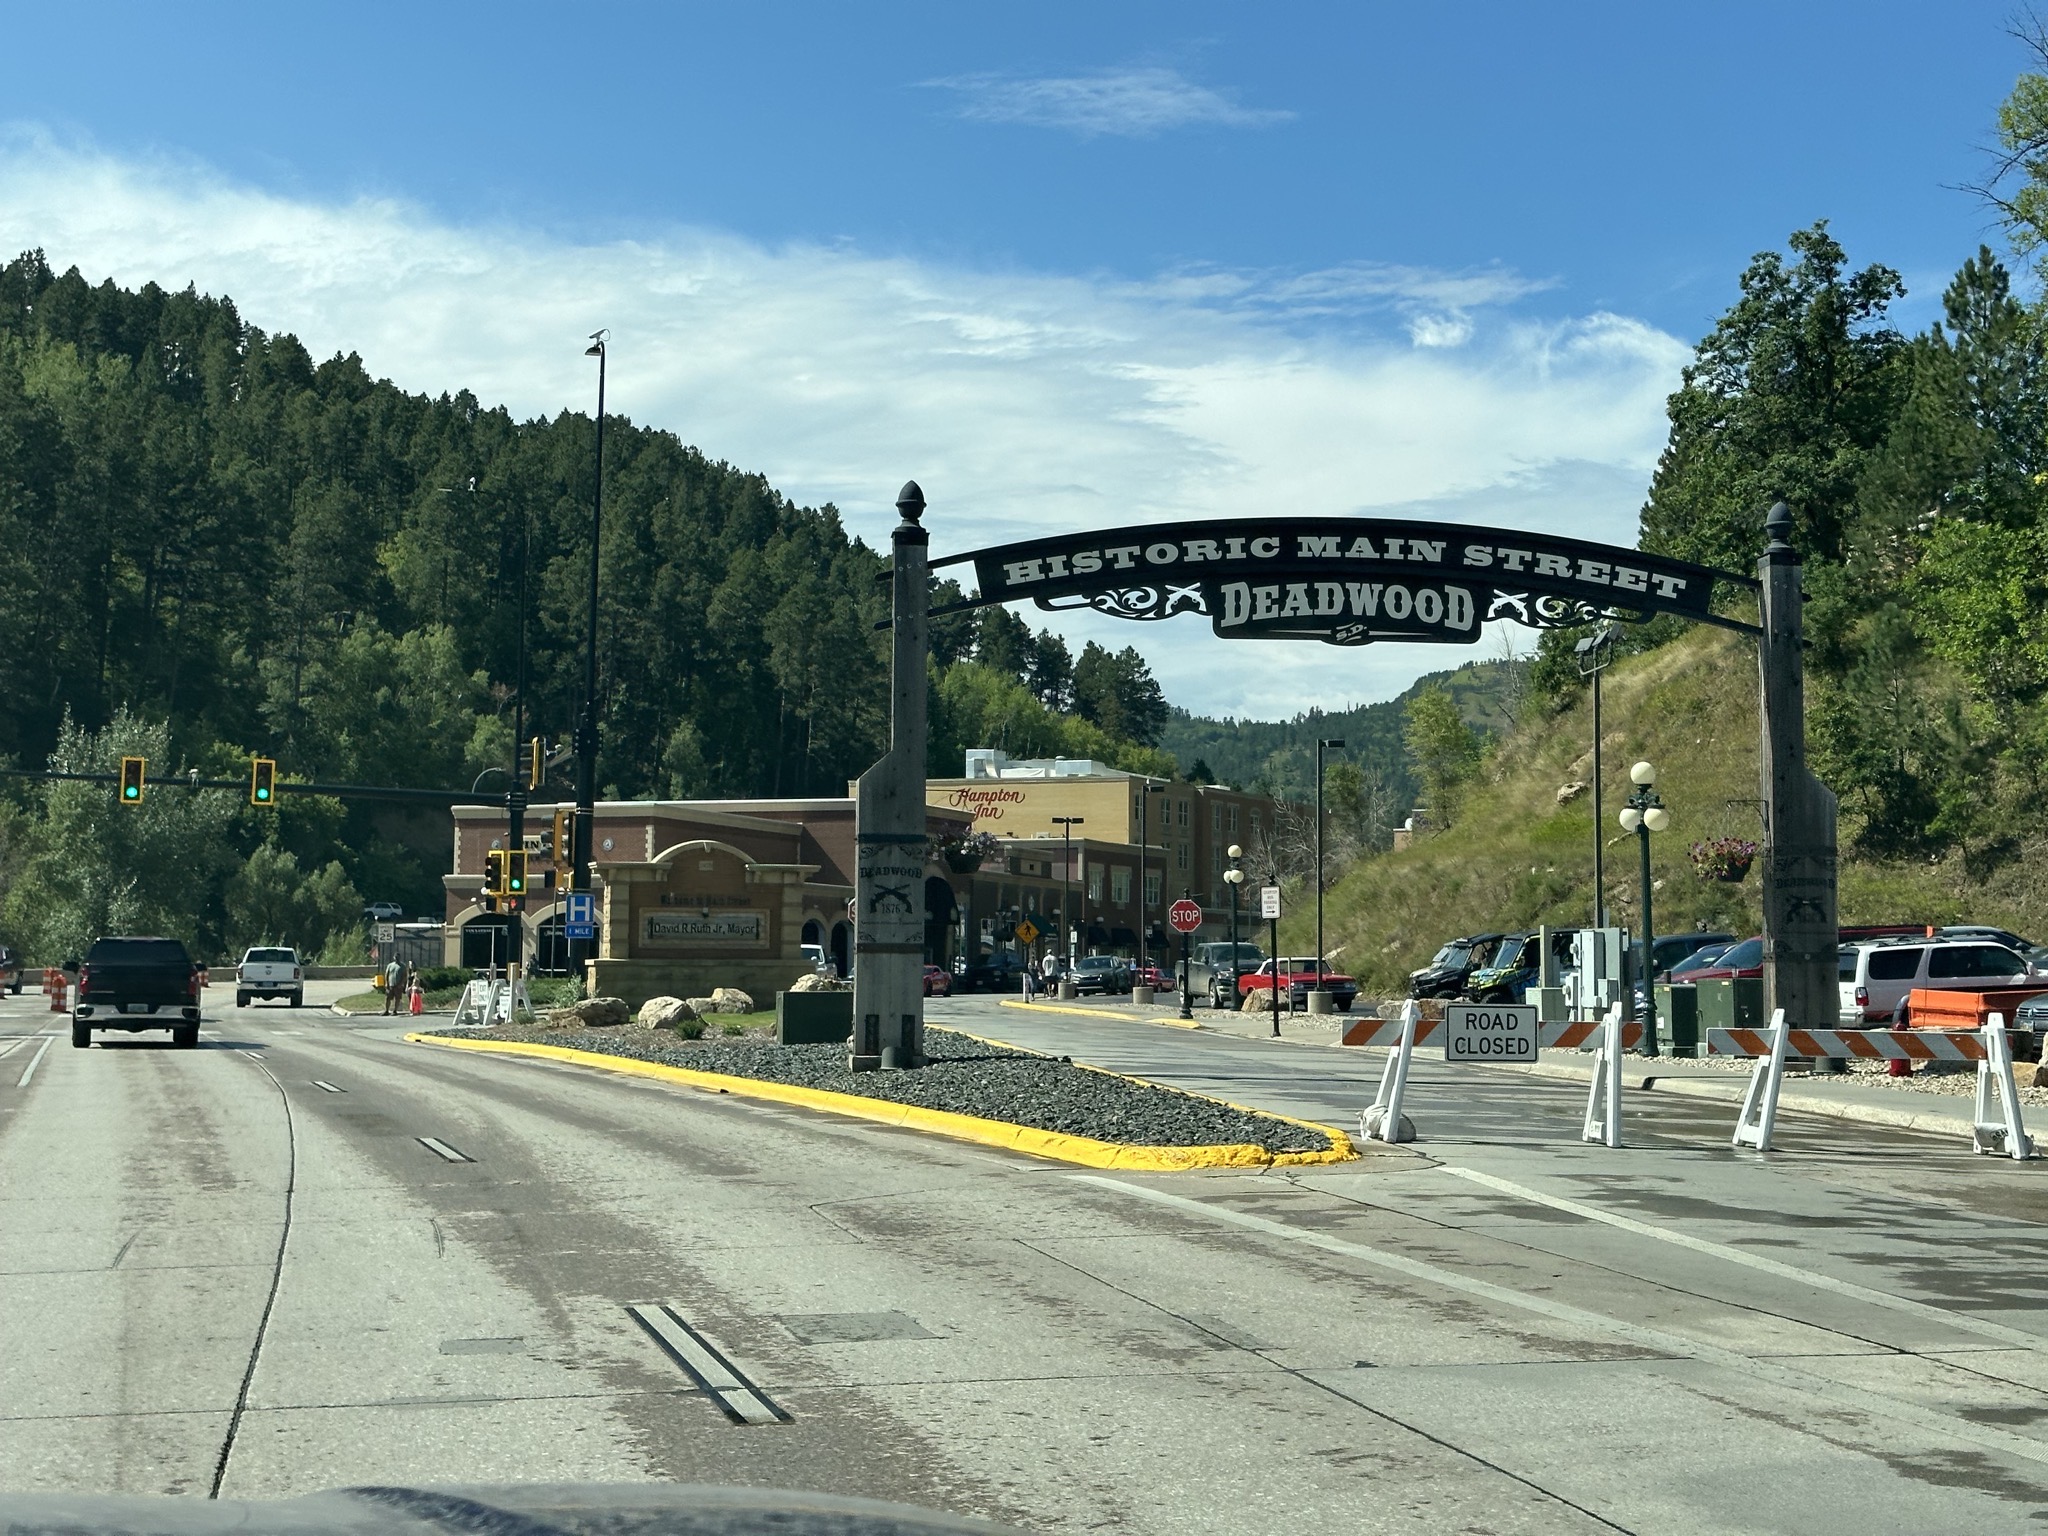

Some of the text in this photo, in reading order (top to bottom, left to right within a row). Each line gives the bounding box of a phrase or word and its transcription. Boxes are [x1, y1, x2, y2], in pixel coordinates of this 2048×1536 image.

[1003, 536, 1687, 599] HISTORIC MAIN STREET
[1221, 581, 1475, 631] DEADWOOD
[1335, 624, 1368, 641] S.D.
[949, 787, 1026, 807] Hampton
[973, 803, 1004, 822] Inn
[860, 866, 922, 878] DEADWOOD
[881, 903, 901, 914] 1876
[1172, 910, 1199, 922] STOP
[380, 933, 392, 941] 25
[574, 926, 590, 935] MILE
[654, 923, 680, 934] David
[690, 923, 711, 934] Ruth
[727, 923, 755, 936] Mayor
[1466, 1013, 1518, 1030] ROAD
[1455, 1037, 1529, 1054] CLOSED
